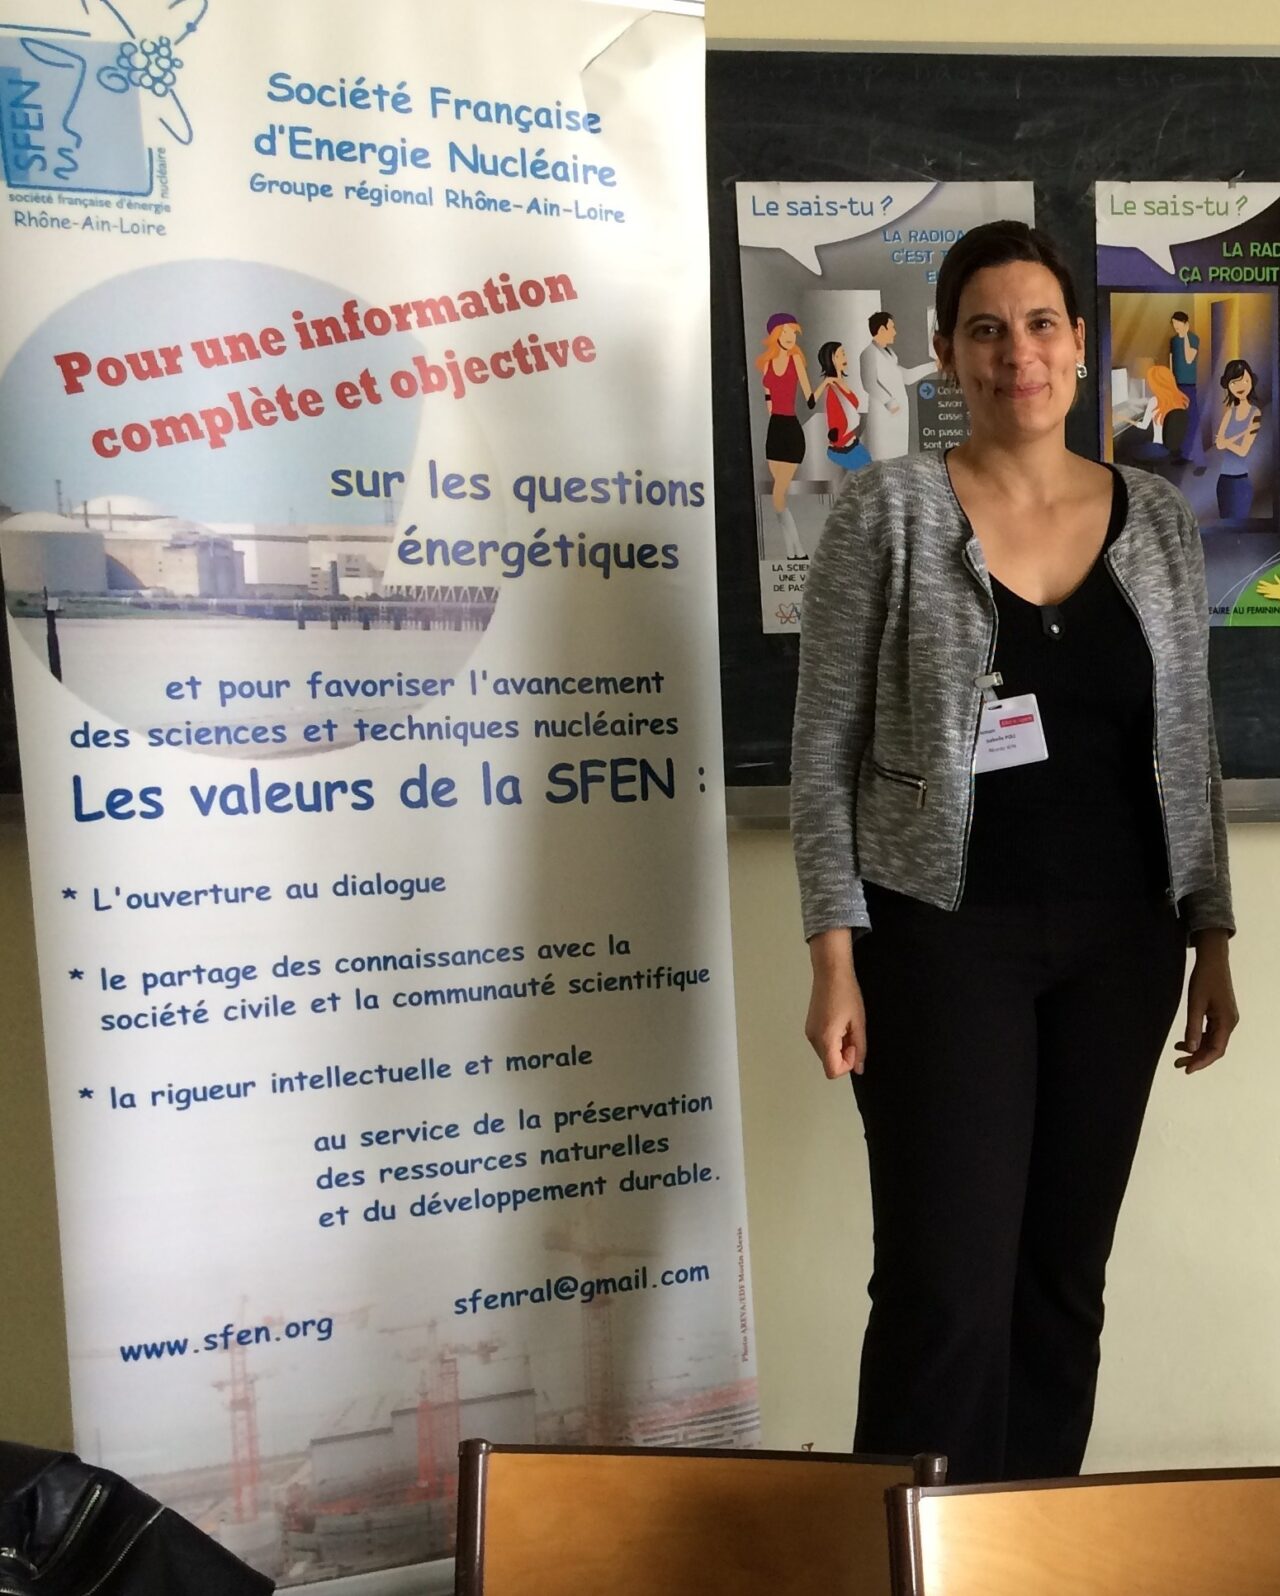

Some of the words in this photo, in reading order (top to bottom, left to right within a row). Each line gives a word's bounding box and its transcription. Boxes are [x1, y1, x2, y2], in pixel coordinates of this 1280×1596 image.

[9, 78, 47, 171] SFEN
[267, 72, 412, 114] Société
[430, 86, 602, 134] Française
[254, 123, 431, 175] d'Energie
[448, 141, 614, 186] Nucléaire
[249, 172, 333, 202] Groupe
[344, 180, 433, 207] régional
[445, 188, 624, 222] Rhône-Ain-Loire
[751, 195, 779, 216] Le
[786, 195, 873, 216] sais-tu
[1110, 194, 1136, 215] Le
[1143, 194, 1228, 216] sais-tu
[14, 210, 165, 236] Rhône-Ain-Loire
[883, 230, 903, 243] LA
[1222, 241, 1243, 257] LA
[1178, 266, 1201, 284] ÇA
[1208, 266, 1279, 281] PRODUIT
[53, 345, 182, 395] Pour
[191, 326, 285, 368] une
[291, 273, 576, 350] information
[90, 385, 324, 458] complète
[334, 369, 375, 408] et
[389, 334, 594, 399] objective
[330, 468, 404, 498] sur
[429, 462, 490, 500] les
[512, 469, 705, 509] questions
[397, 524, 678, 579] énergétiques
[771, 564, 783, 572] LA
[165, 675, 202, 700] et
[218, 679, 290, 704] pour
[306, 671, 454, 699] favoriser
[470, 670, 664, 695] l'avancement
[69, 720, 130, 748] des
[147, 720, 287, 747] sciences
[303, 718, 338, 742] et
[353, 714, 518, 745] techniques
[534, 712, 678, 737] nucléaires
[72, 774, 164, 822] Les
[189, 767, 374, 816] valeurs
[400, 763, 457, 809] de
[482, 761, 521, 805] la
[546, 757, 674, 803] SFEN
[93, 883, 271, 911] L'ouverture
[285, 882, 318, 899] au
[332, 872, 445, 900] dialogue
[100, 967, 127, 991] le
[142, 964, 257, 994] partage
[272, 955, 321, 977] des
[335, 946, 524, 971] connaissances
[537, 942, 594, 959] avec
[609, 934, 630, 954] la
[100, 999, 209, 1031] société
[223, 994, 296, 1021] civile
[310, 992, 340, 1013] et
[355, 988, 379, 1010] la
[392, 973, 555, 1007] communauté
[569, 966, 709, 993] scientifique
[110, 1086, 136, 1109] la
[151, 1080, 256, 1110] rigueur
[271, 1057, 451, 1093] intellectuelle
[465, 1055, 492, 1075] et
[506, 1045, 592, 1071] morale
[314, 1133, 346, 1152] au
[360, 1120, 459, 1147] service
[473, 1112, 505, 1135] de
[519, 1109, 541, 1130] la
[554, 1094, 712, 1133] préservation
[316, 1166, 365, 1189] des
[379, 1152, 527, 1183] ressources
[540, 1134, 668, 1164] naturelles
[318, 1206, 349, 1227] et
[363, 1199, 395, 1222] du
[409, 1176, 606, 1217] développement
[619, 1163, 719, 1191] durable.
[454, 1265, 709, 1315] sfenral@gmail.com
[120, 1317, 332, 1362] www.sfen.org
